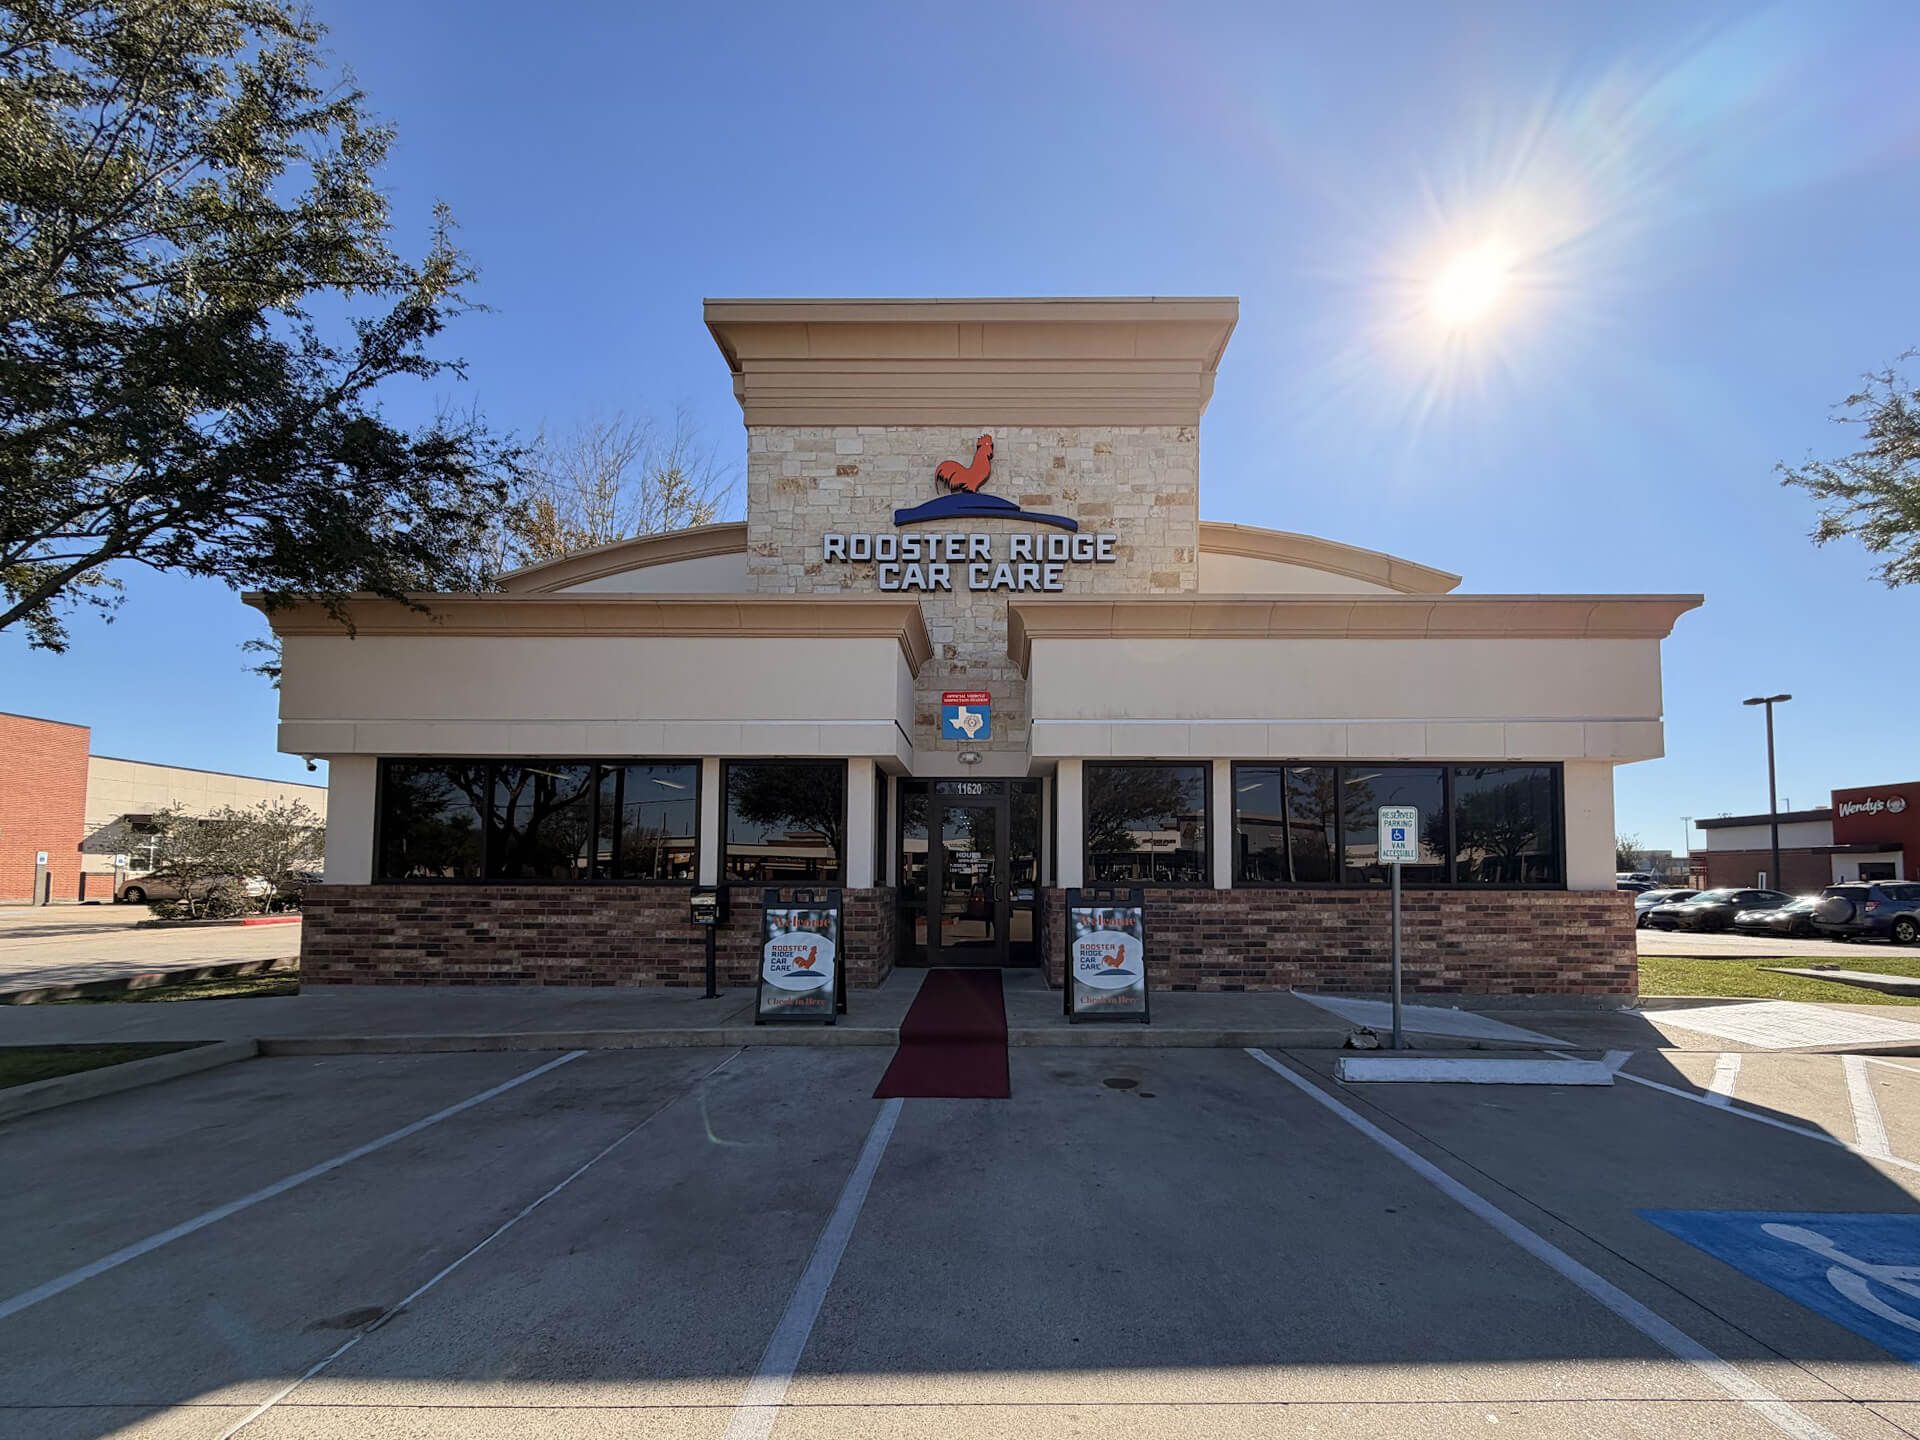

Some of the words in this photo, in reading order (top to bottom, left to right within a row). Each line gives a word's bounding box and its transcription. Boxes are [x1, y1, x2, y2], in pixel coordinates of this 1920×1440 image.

[823, 534, 992, 562] ROOSTER
[1010, 534, 1117, 562] RIDGE
[879, 563, 952, 592] CAR
[969, 563, 1065, 592] CARE
[957, 783, 982, 795] 11620
[1839, 797, 1885, 817] Wendy's
[1382, 811, 1414, 819] RESERVED
[1384, 820, 1413, 828] PARKING
[1383, 849, 1414, 857] ACCESSIBLE
[770, 957, 787, 965] CAR
